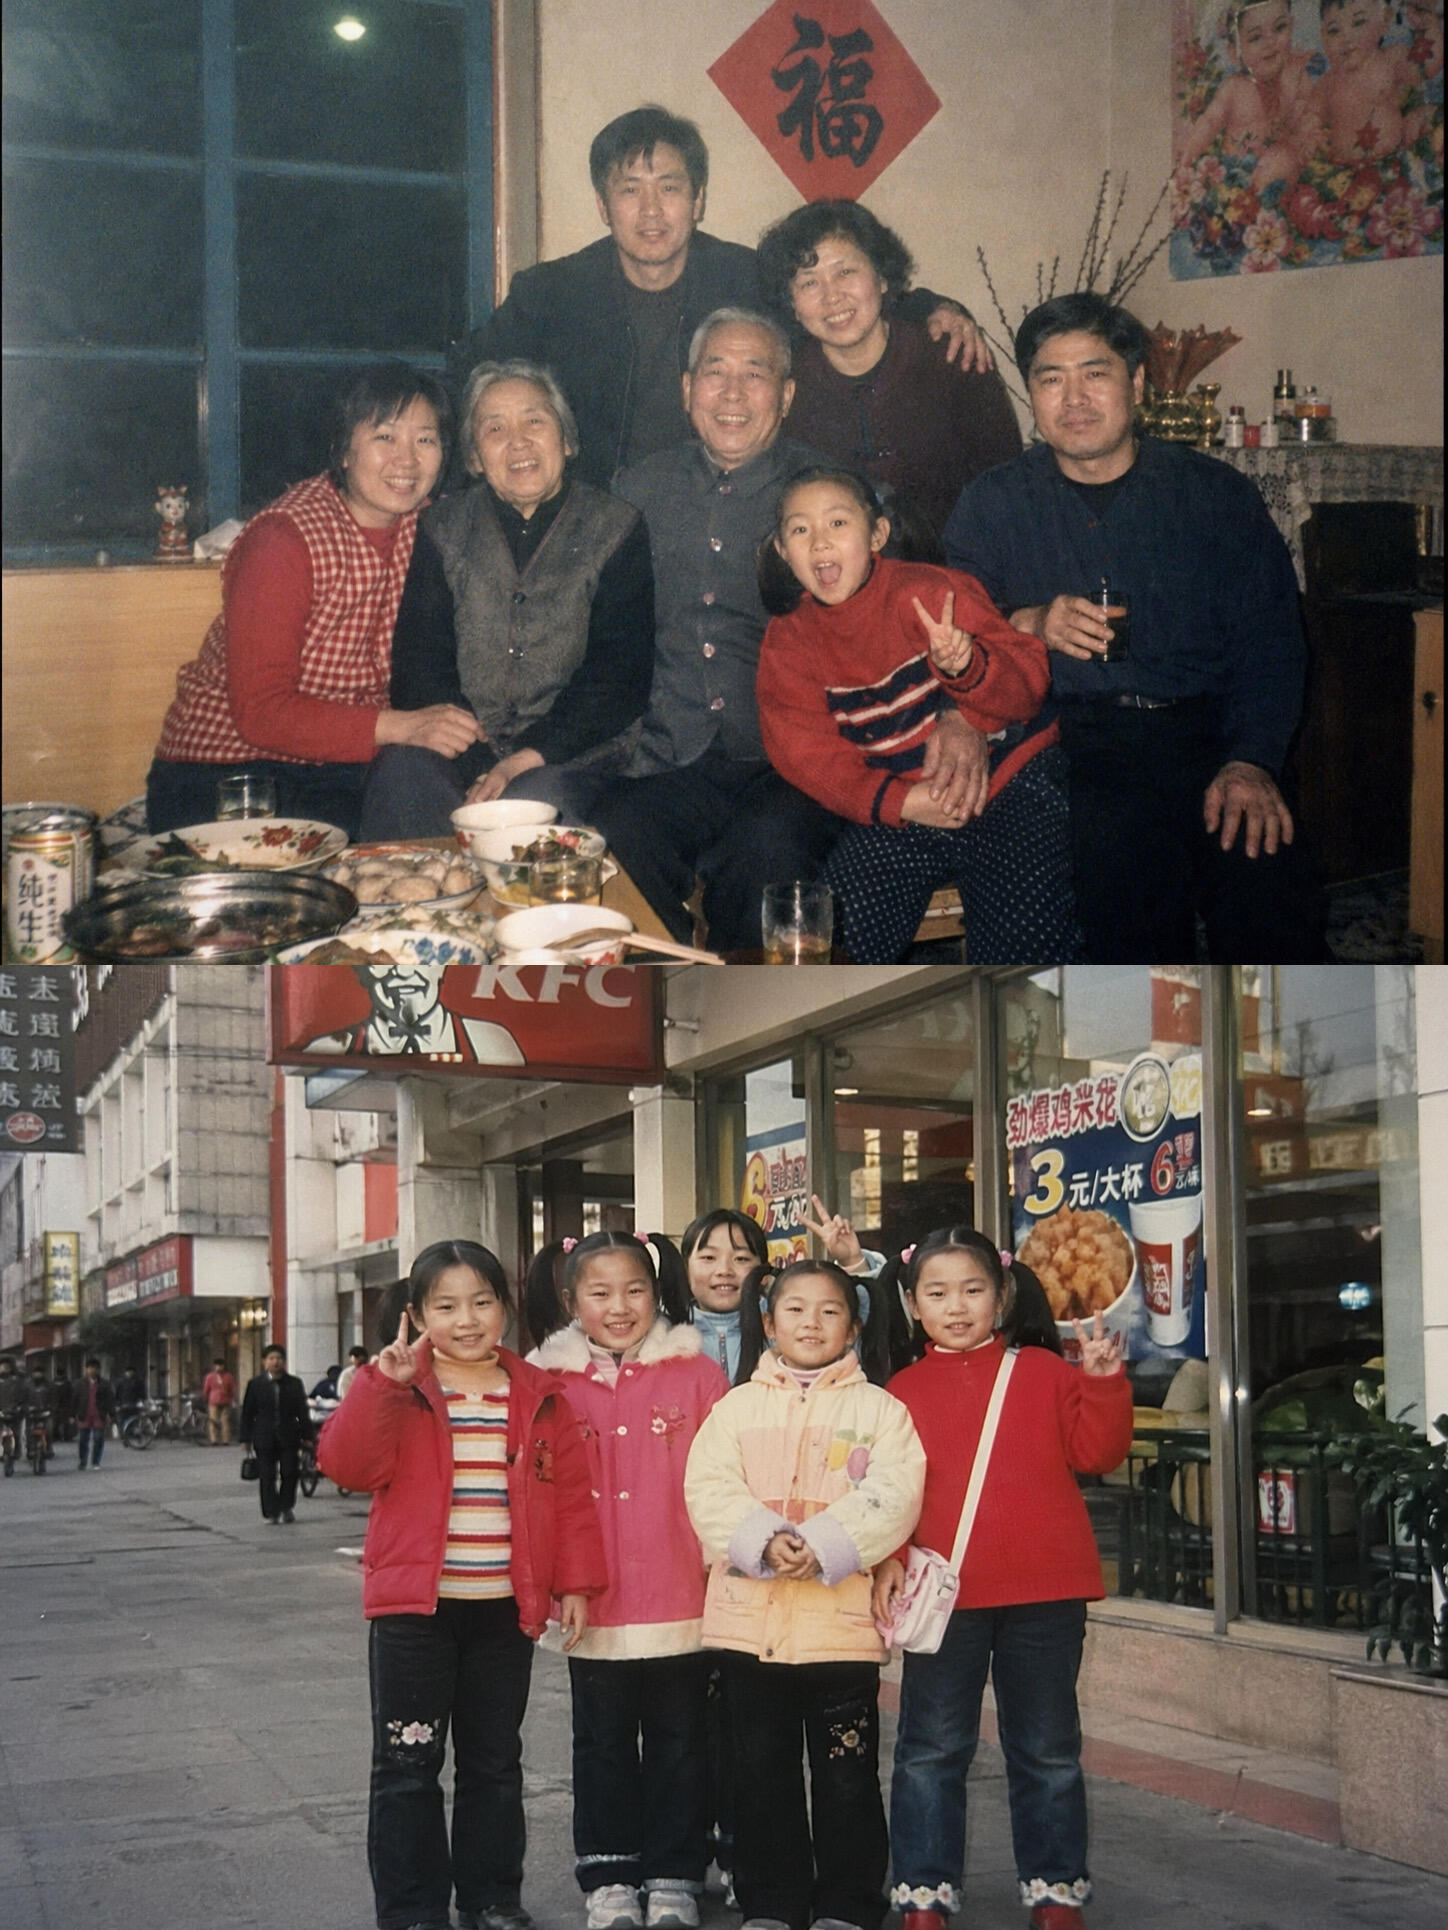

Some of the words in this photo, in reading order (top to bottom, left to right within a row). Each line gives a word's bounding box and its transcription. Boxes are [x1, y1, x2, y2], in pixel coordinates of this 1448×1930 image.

[771, 12, 884, 168] 福
[18, 873, 44, 943] 纯生
[472, 965, 635, 1007] KFC
[1008, 1077, 1118, 1143] 劲爆鸡米花
